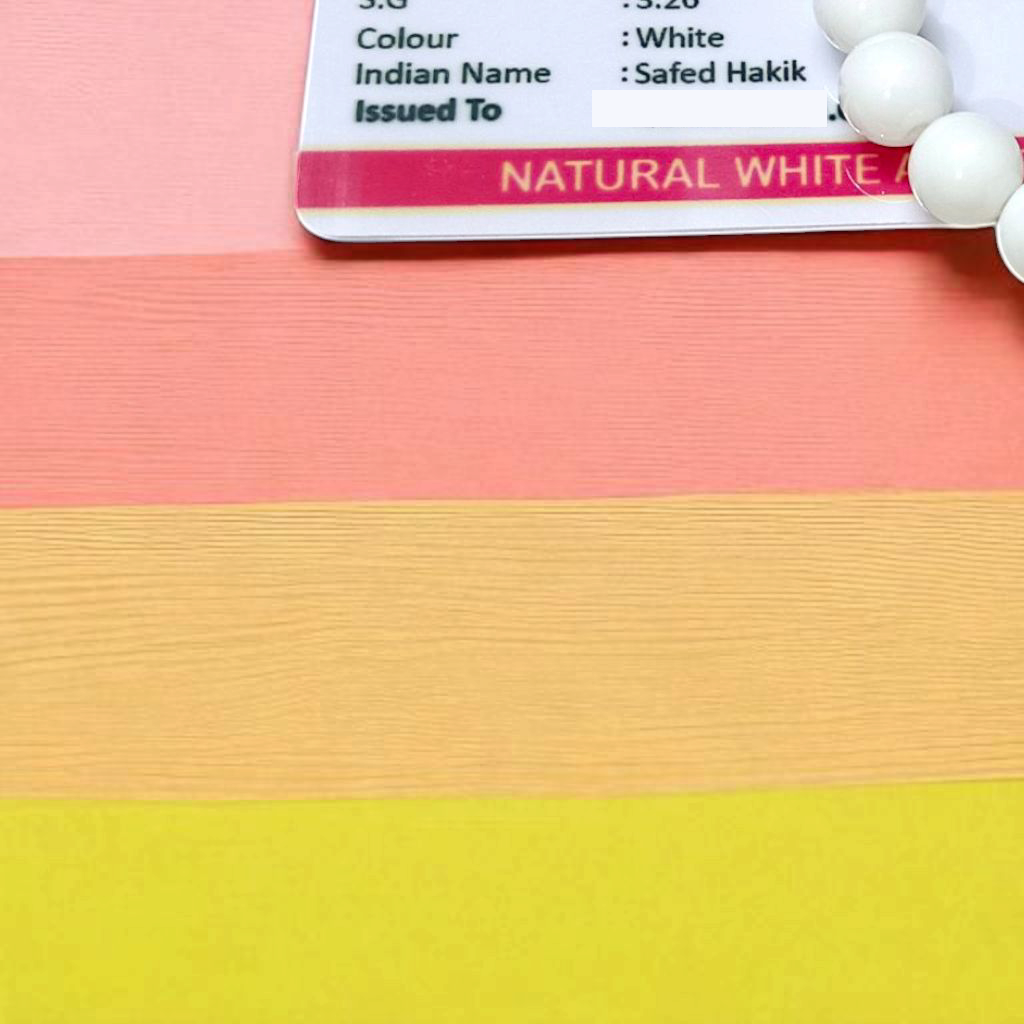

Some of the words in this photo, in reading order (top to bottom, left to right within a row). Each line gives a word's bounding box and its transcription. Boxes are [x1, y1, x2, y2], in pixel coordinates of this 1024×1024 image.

[357, 27, 459, 49] Colour
[636, 26, 725, 48] White
[356, 62, 450, 85] Indian
[461, 62, 552, 84] Name
[634, 61, 716, 84] Safed
[727, 59, 807, 83] Hakik
[356, 97, 457, 123] Issued
[465, 97, 503, 121] To
[501, 157, 721, 193] NATURAL
[735, 153, 882, 187] WHITE
